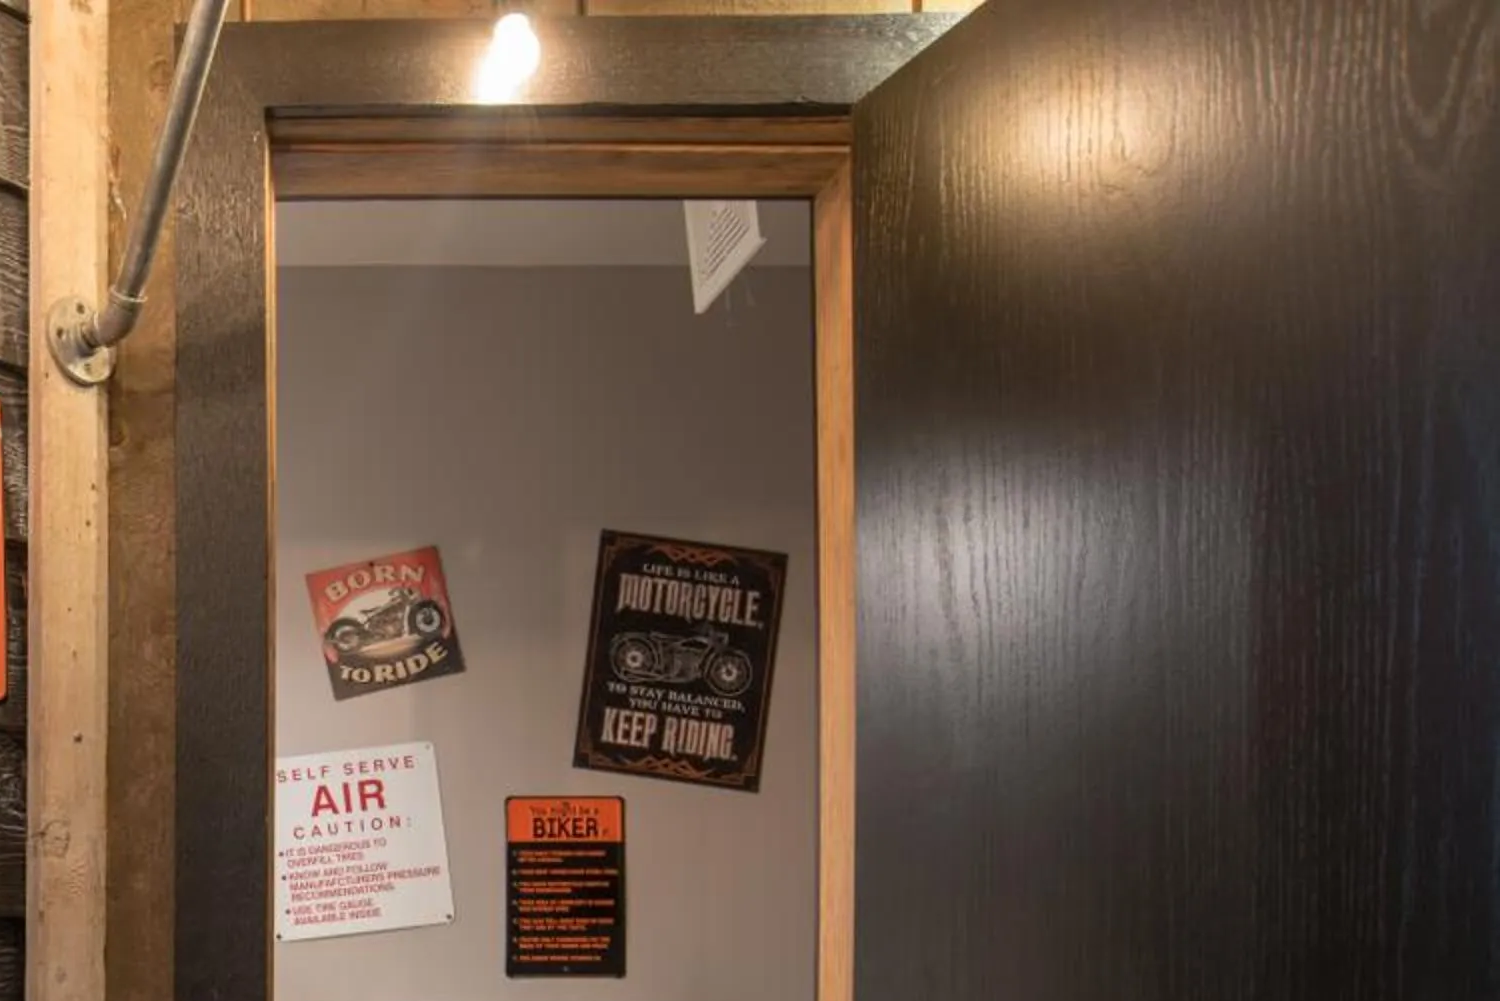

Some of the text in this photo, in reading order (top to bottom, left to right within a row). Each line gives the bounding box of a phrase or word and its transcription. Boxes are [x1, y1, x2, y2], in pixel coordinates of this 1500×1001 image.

[325, 564, 426, 602] BORN
[340, 641, 449, 683] TO RIDE
[630, 685, 663, 700] STAY
[661, 702, 700, 716] HAVE
[601, 706, 658, 749] KEEP
[277, 755, 415, 783] SELF SERVE
[311, 779, 387, 817] AIR
[532, 817, 599, 839] BIKER
